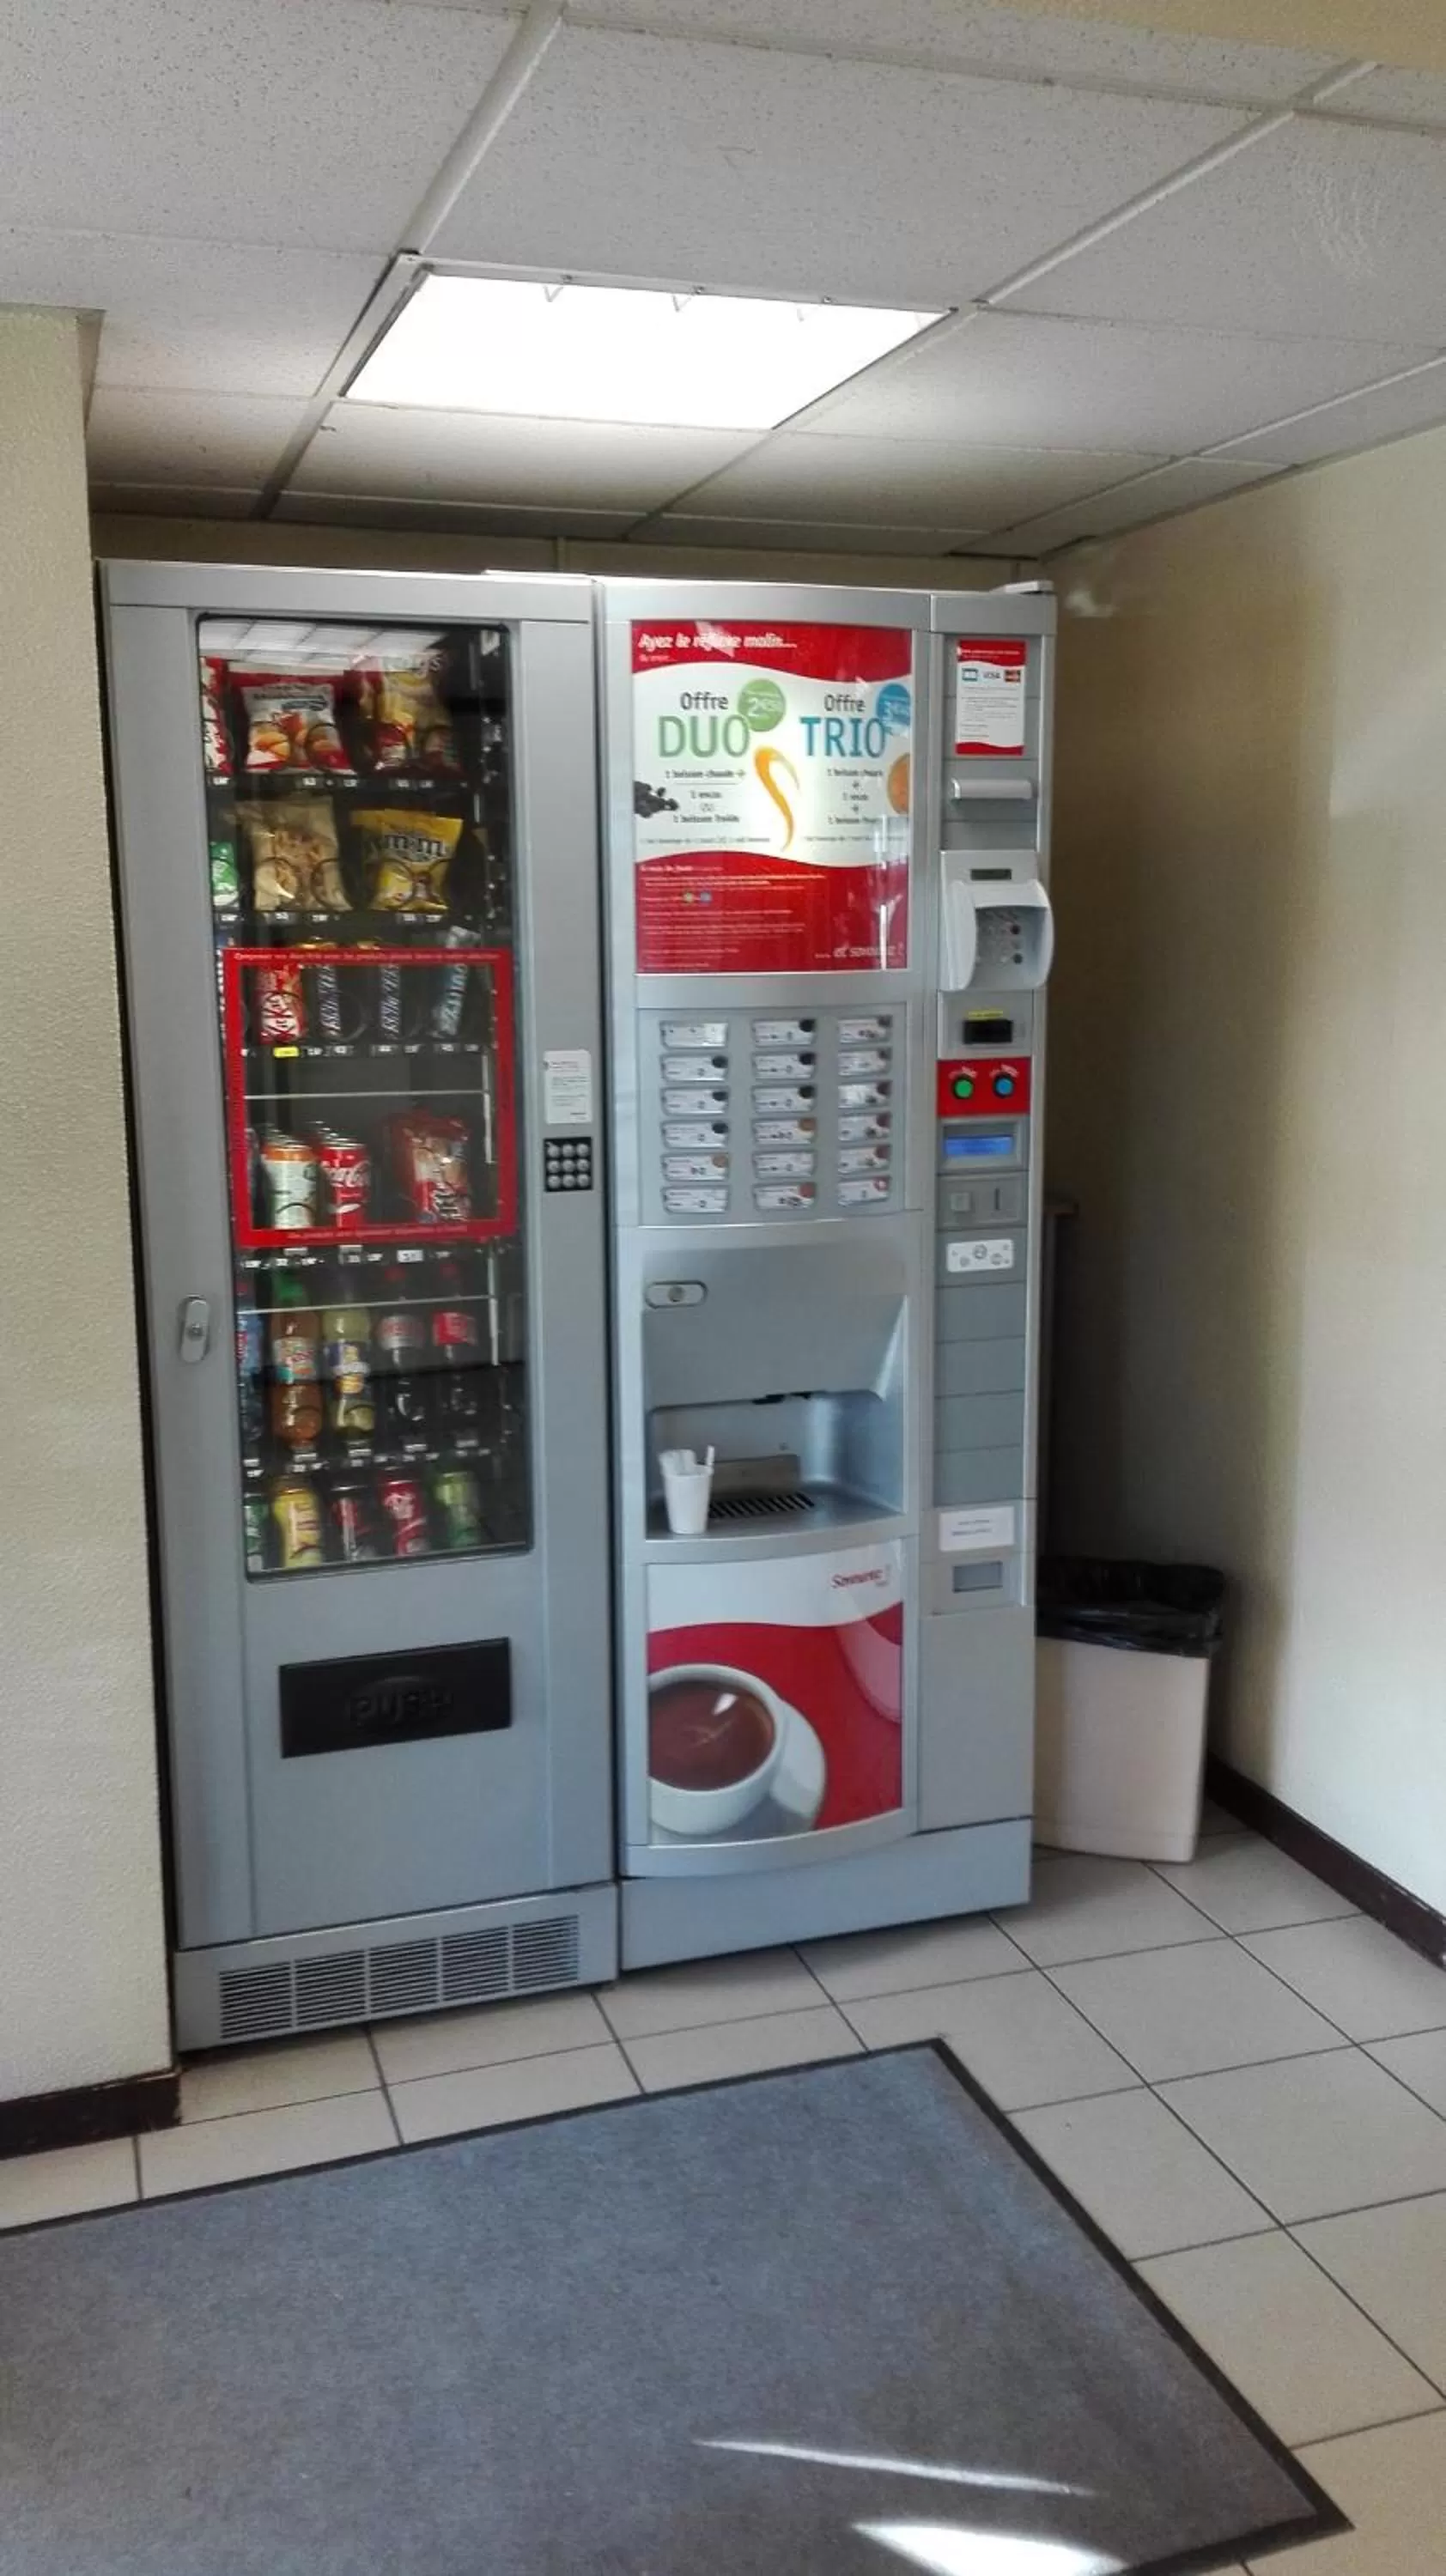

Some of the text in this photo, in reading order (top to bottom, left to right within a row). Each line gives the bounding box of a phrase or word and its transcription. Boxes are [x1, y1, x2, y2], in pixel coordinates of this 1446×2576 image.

[680, 691, 730, 711] Offre
[823, 694, 866, 713] Offre
[658, 714, 750, 758] DUO
[799, 716, 886, 758] TRIO
